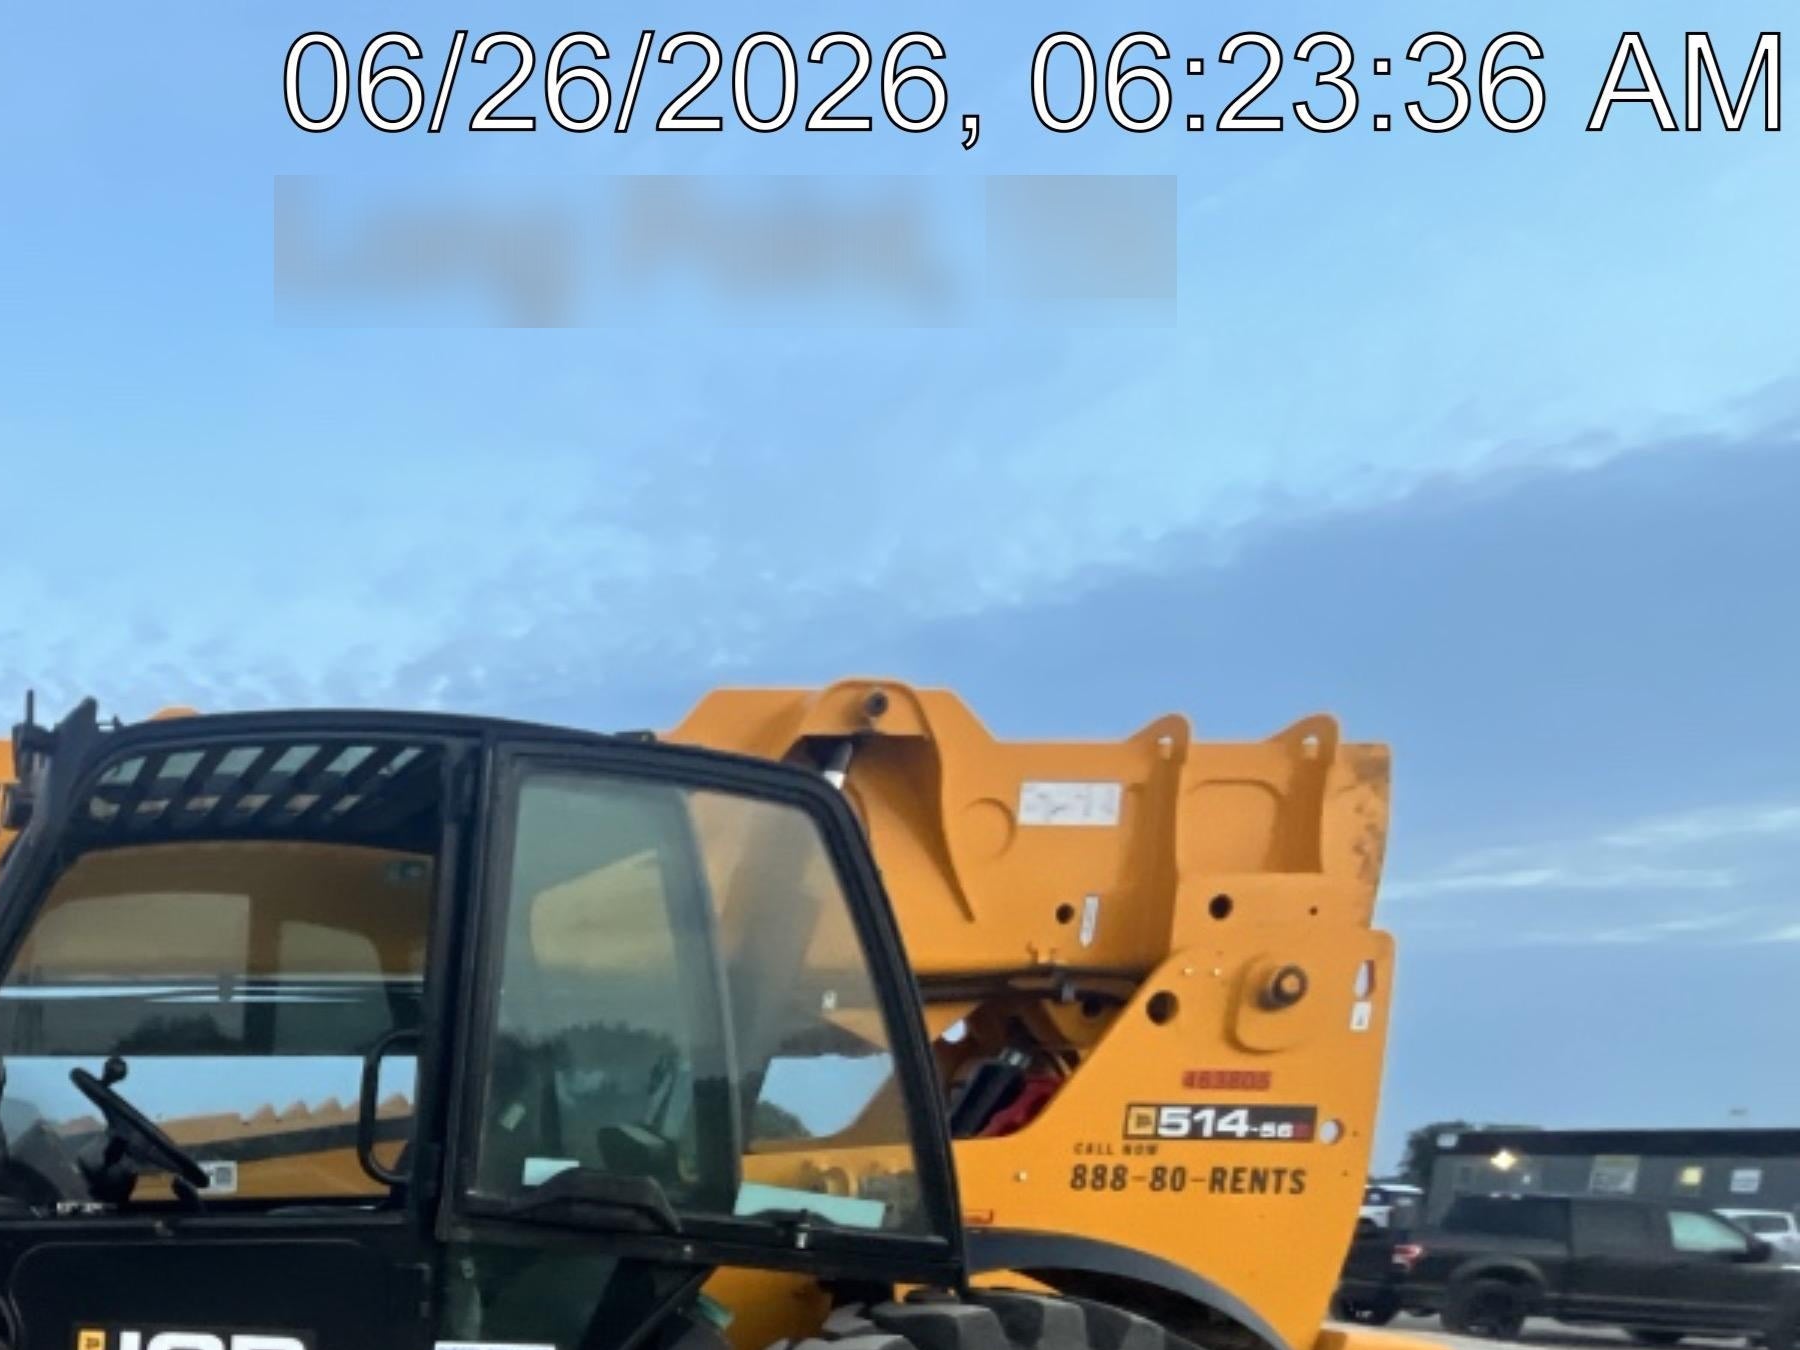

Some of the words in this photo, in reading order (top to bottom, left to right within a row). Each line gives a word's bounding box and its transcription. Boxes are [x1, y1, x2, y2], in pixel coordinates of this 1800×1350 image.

[1073, 1143, 1114, 1155] CALL
[1122, 1144, 1158, 1155] NOW
[1070, 1163, 1308, 1195] 888-80-RENTS
